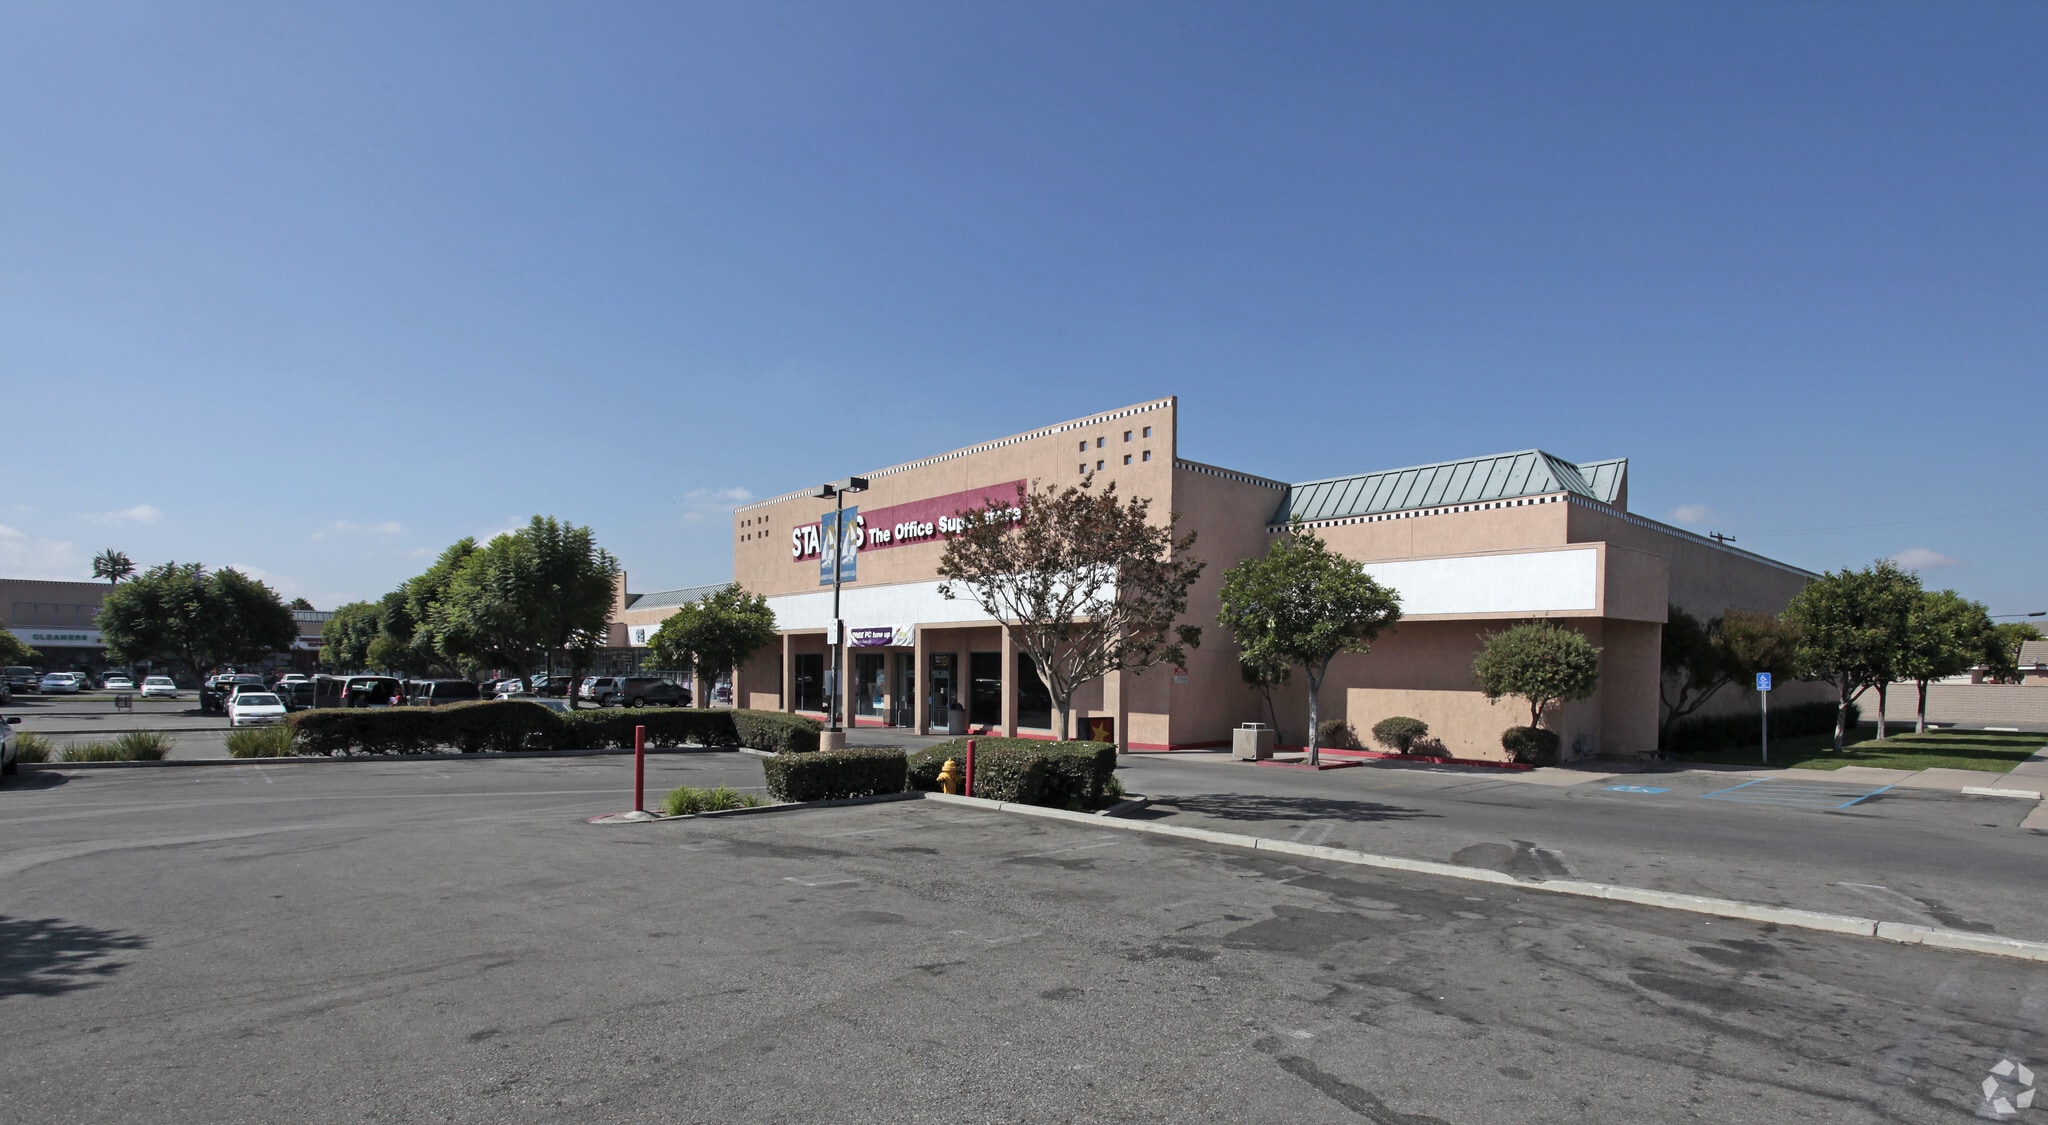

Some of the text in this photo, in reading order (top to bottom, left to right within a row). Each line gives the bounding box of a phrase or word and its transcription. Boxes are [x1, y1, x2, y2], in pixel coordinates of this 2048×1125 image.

[792, 515, 865, 557] STAS
[869, 527, 891, 544] The
[894, 520, 934, 540] Office
[883, 631, 891, 639] up
